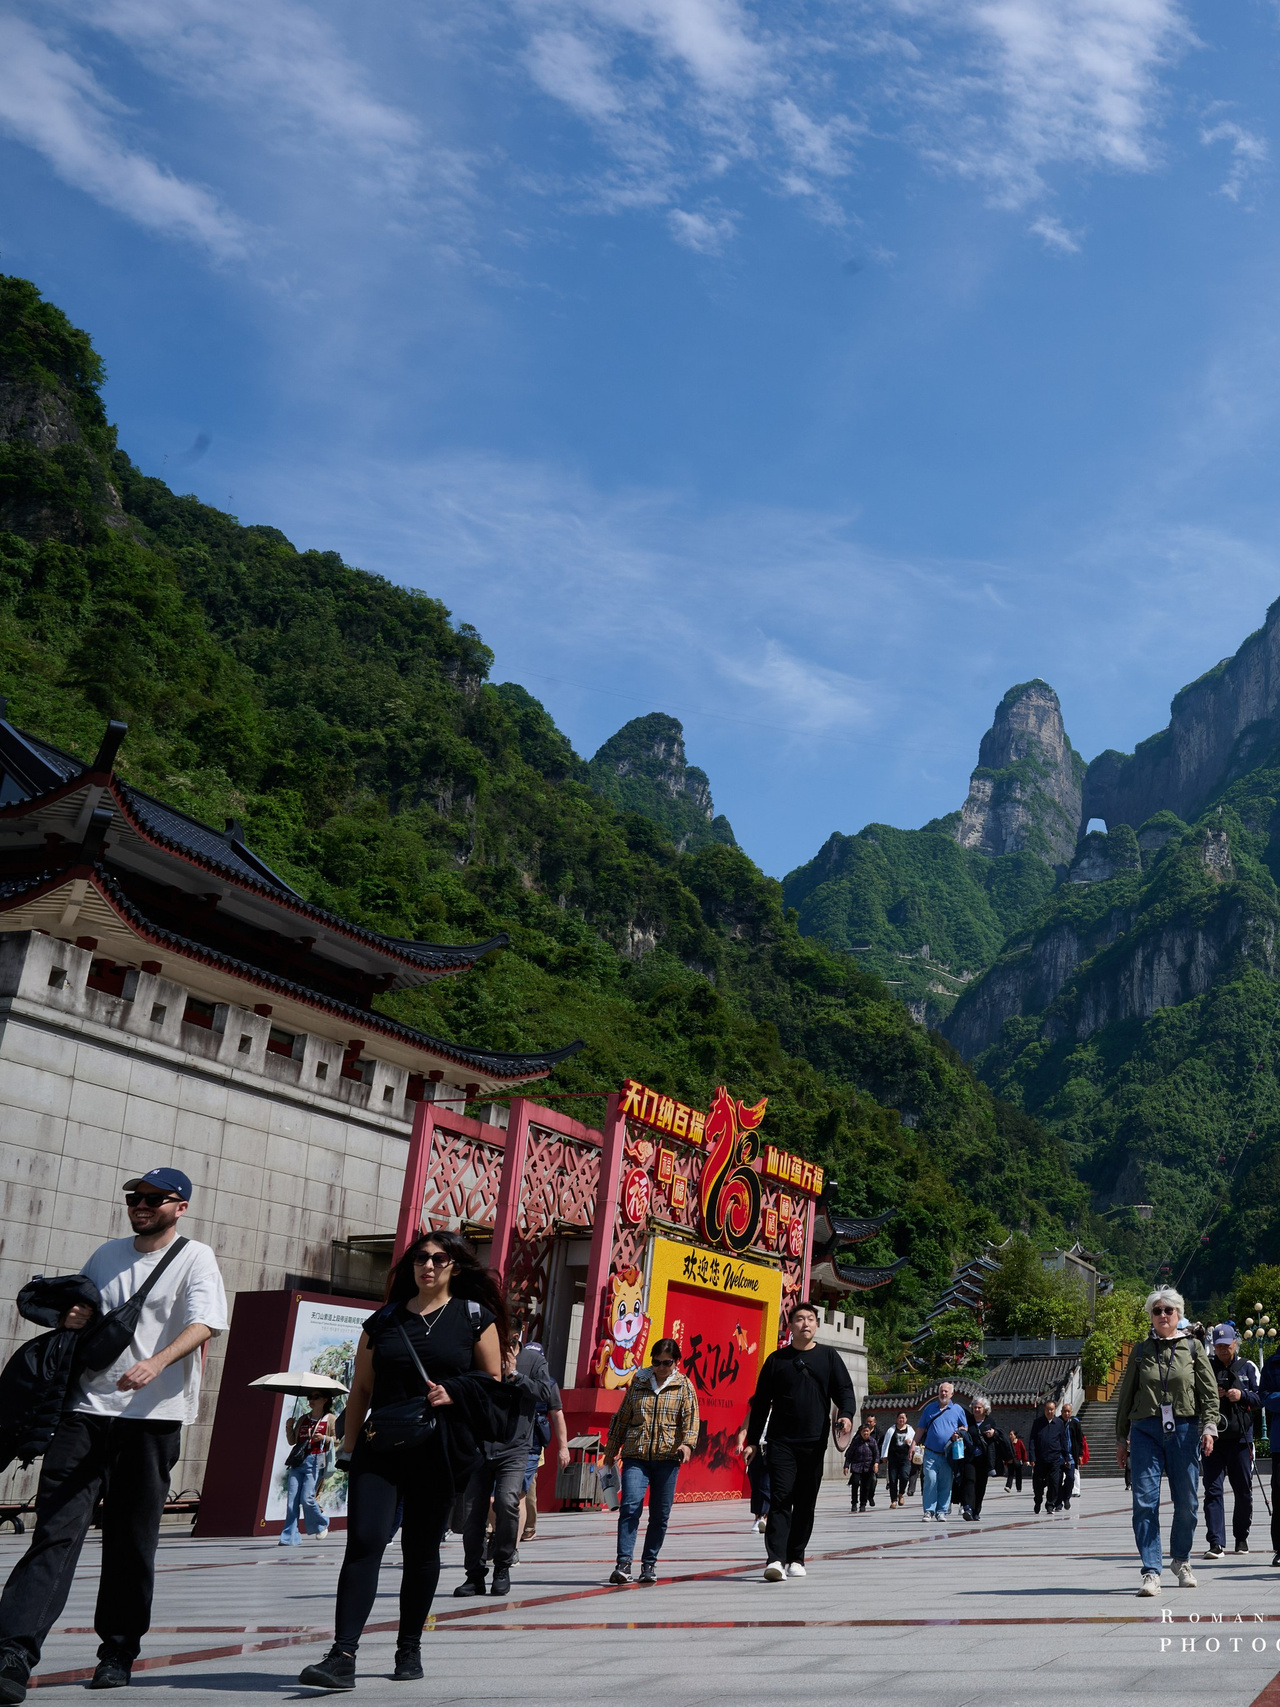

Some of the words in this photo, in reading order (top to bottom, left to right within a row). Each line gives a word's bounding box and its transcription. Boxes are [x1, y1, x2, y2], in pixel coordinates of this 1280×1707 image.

[622, 1079, 706, 1145] 天门纳百瑞
[766, 1145, 824, 1195] 仙山蕴万福
[628, 1176, 648, 1218] 福
[682, 1248, 721, 1287] 欢迎您
[722, 1262, 760, 1292] Welcome
[683, 1333, 740, 1396] 天门山
